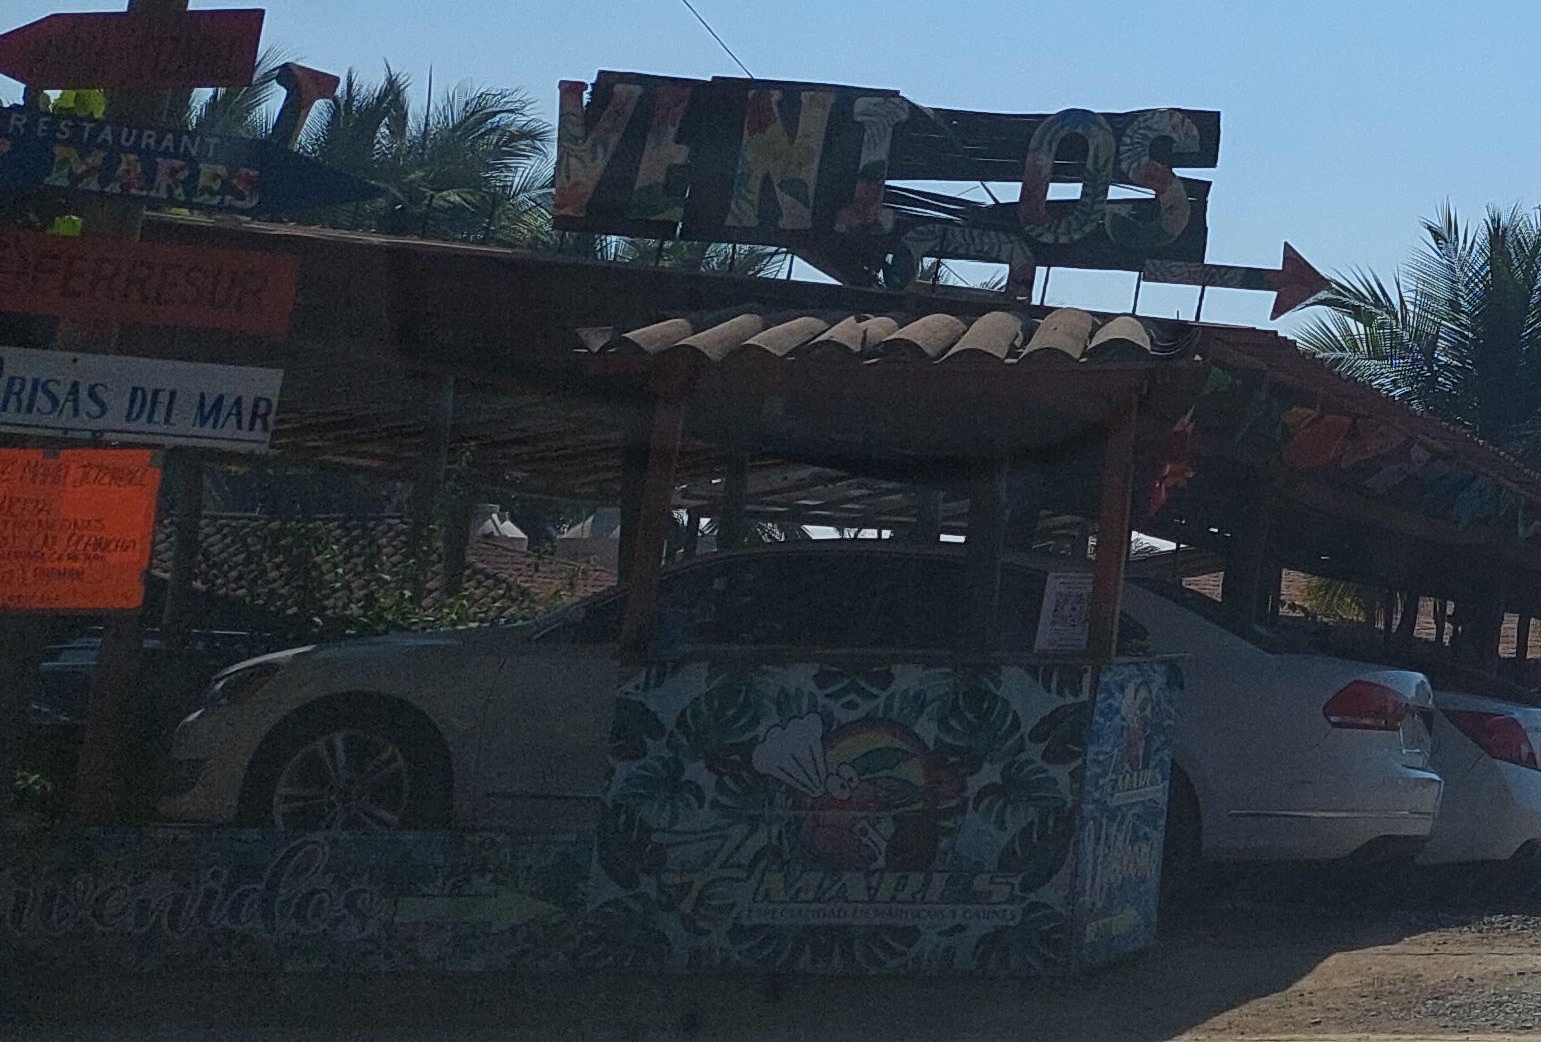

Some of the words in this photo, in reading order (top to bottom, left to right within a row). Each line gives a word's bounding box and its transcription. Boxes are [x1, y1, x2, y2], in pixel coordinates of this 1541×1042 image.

[9, 112, 221, 157] RESTAURANT
[43, 143, 261, 209] MARES
[125, 386, 178, 427] DEL
[192, 391, 274, 433] MAR
[750, 869, 1017, 904] MARES
